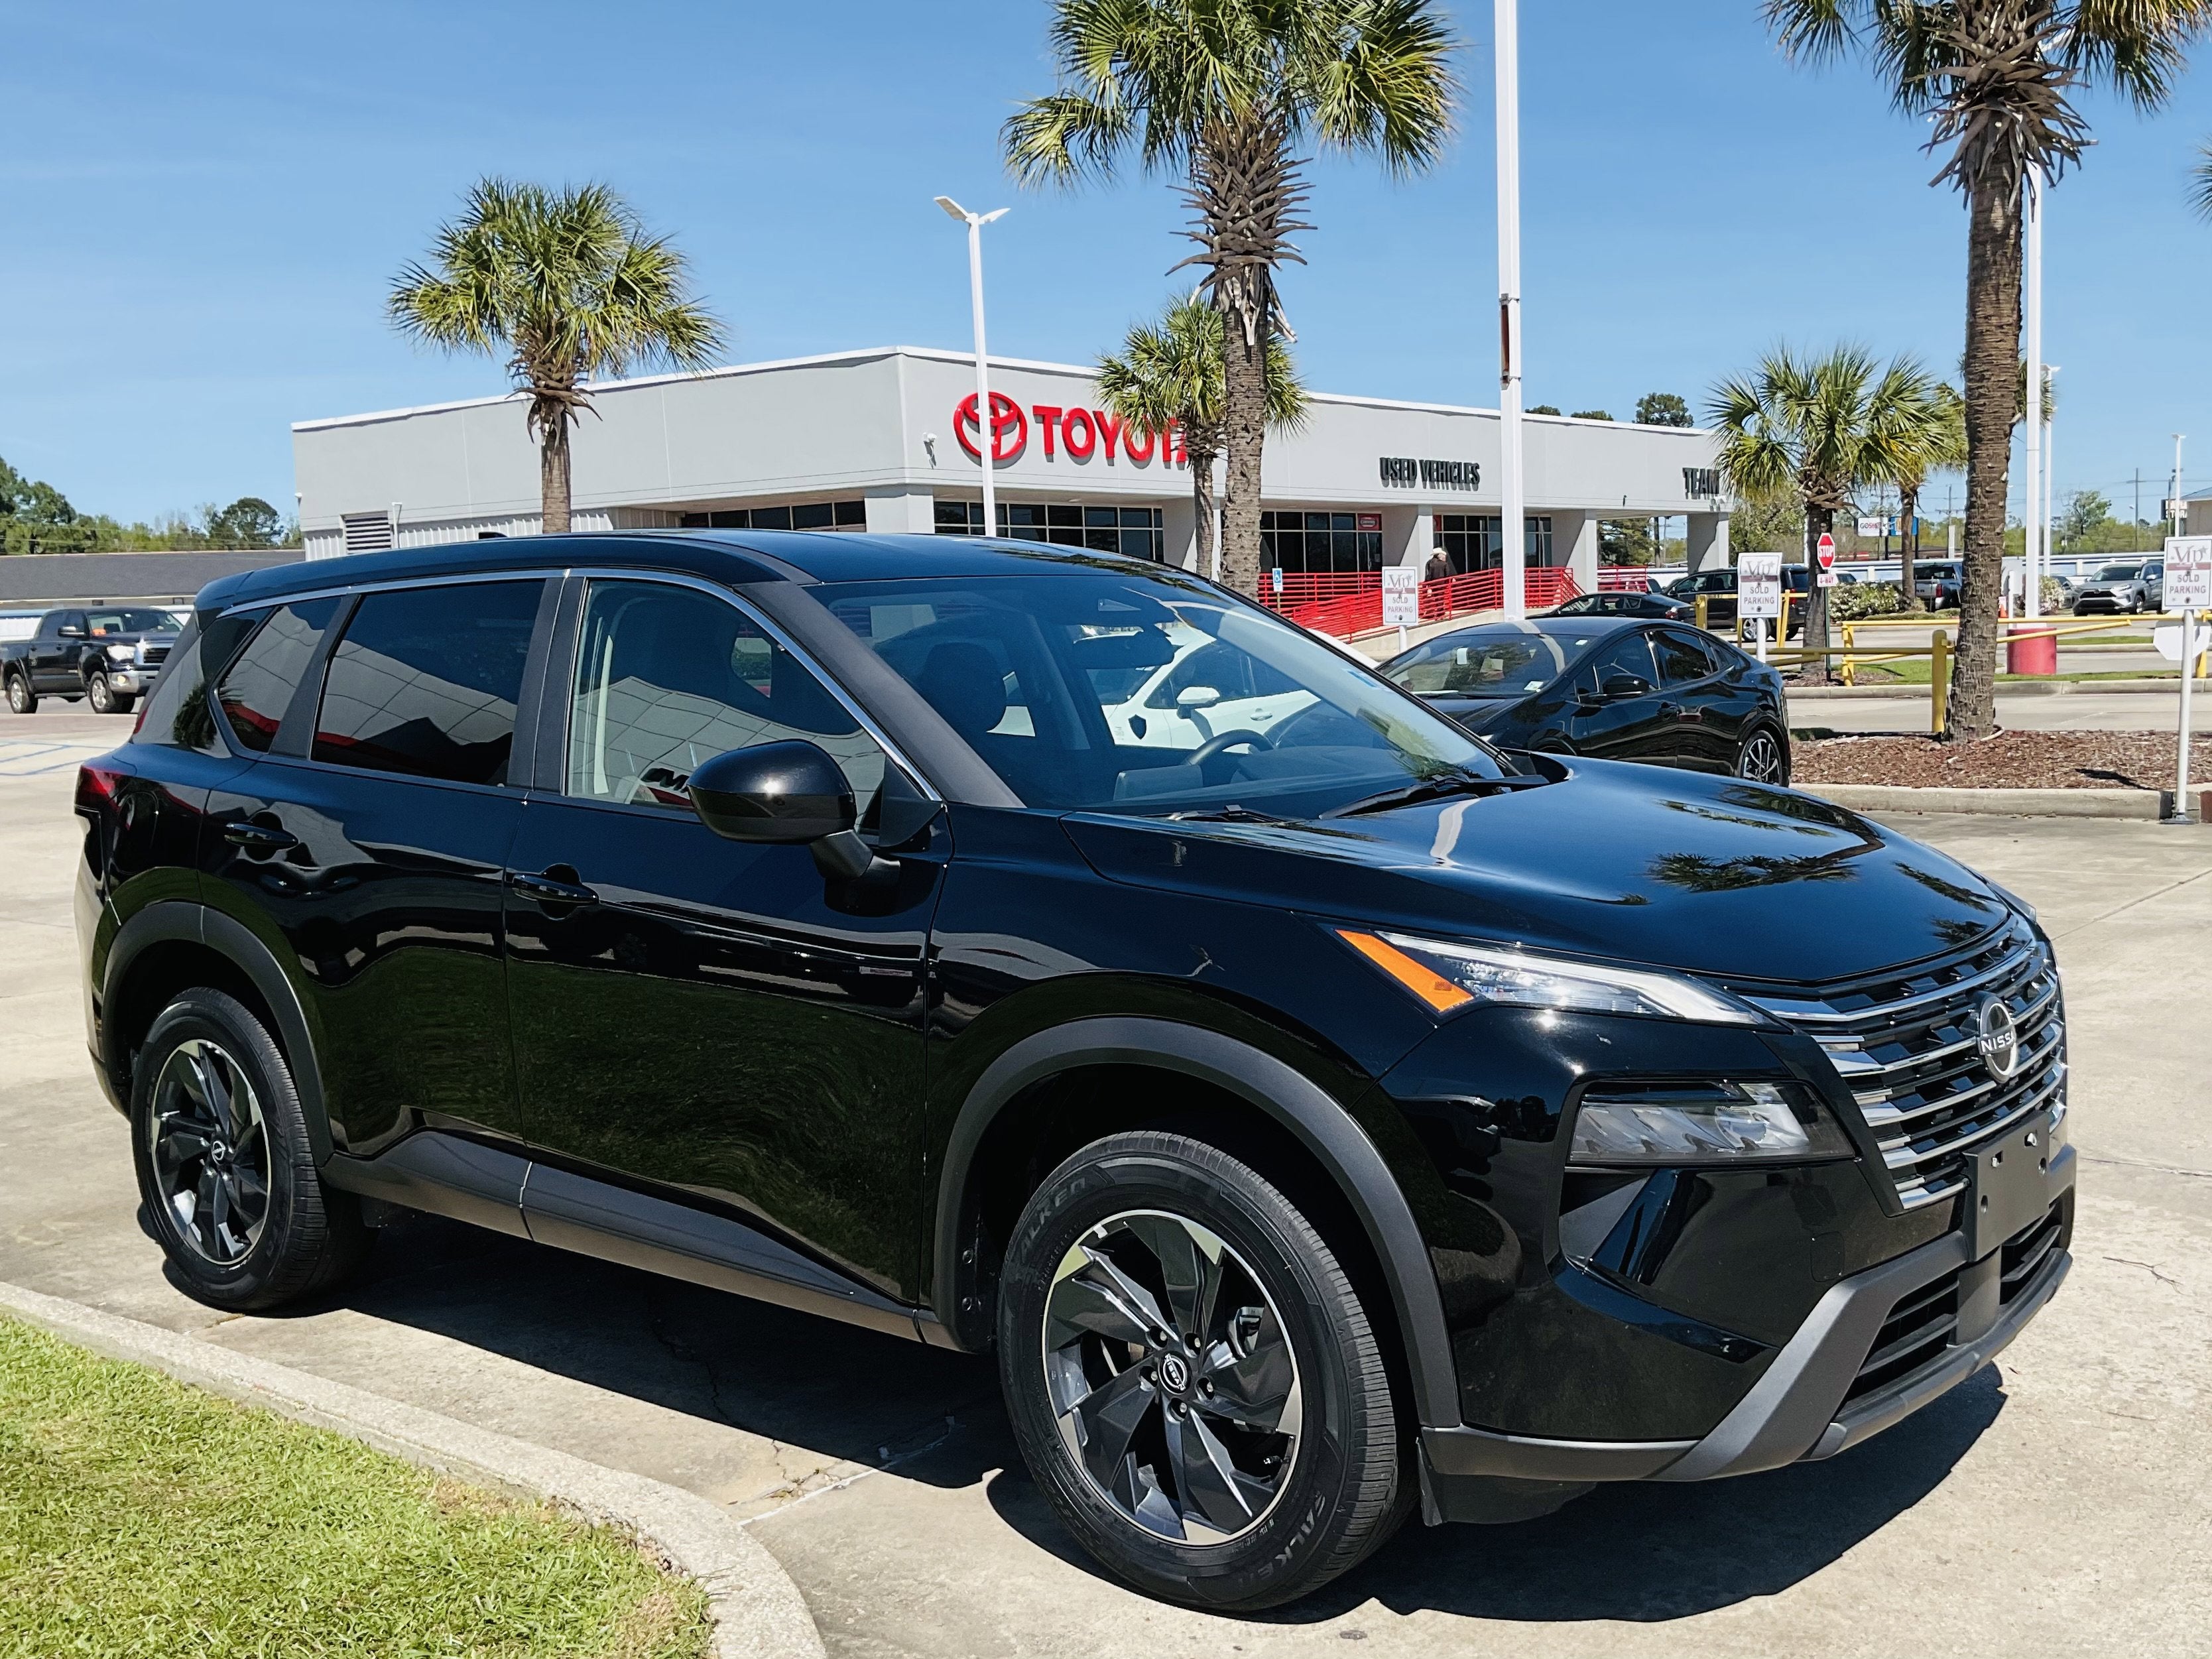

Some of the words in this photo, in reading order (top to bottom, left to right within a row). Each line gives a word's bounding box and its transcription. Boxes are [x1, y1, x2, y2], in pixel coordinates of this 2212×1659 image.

[1380, 458, 1417, 481] USED
[1419, 460, 1480, 485] VEHICLES
[1682, 467, 1720, 494] TEAM
[1819, 545, 1833, 558] STOP
[2169, 585, 2206, 594] PARKING
